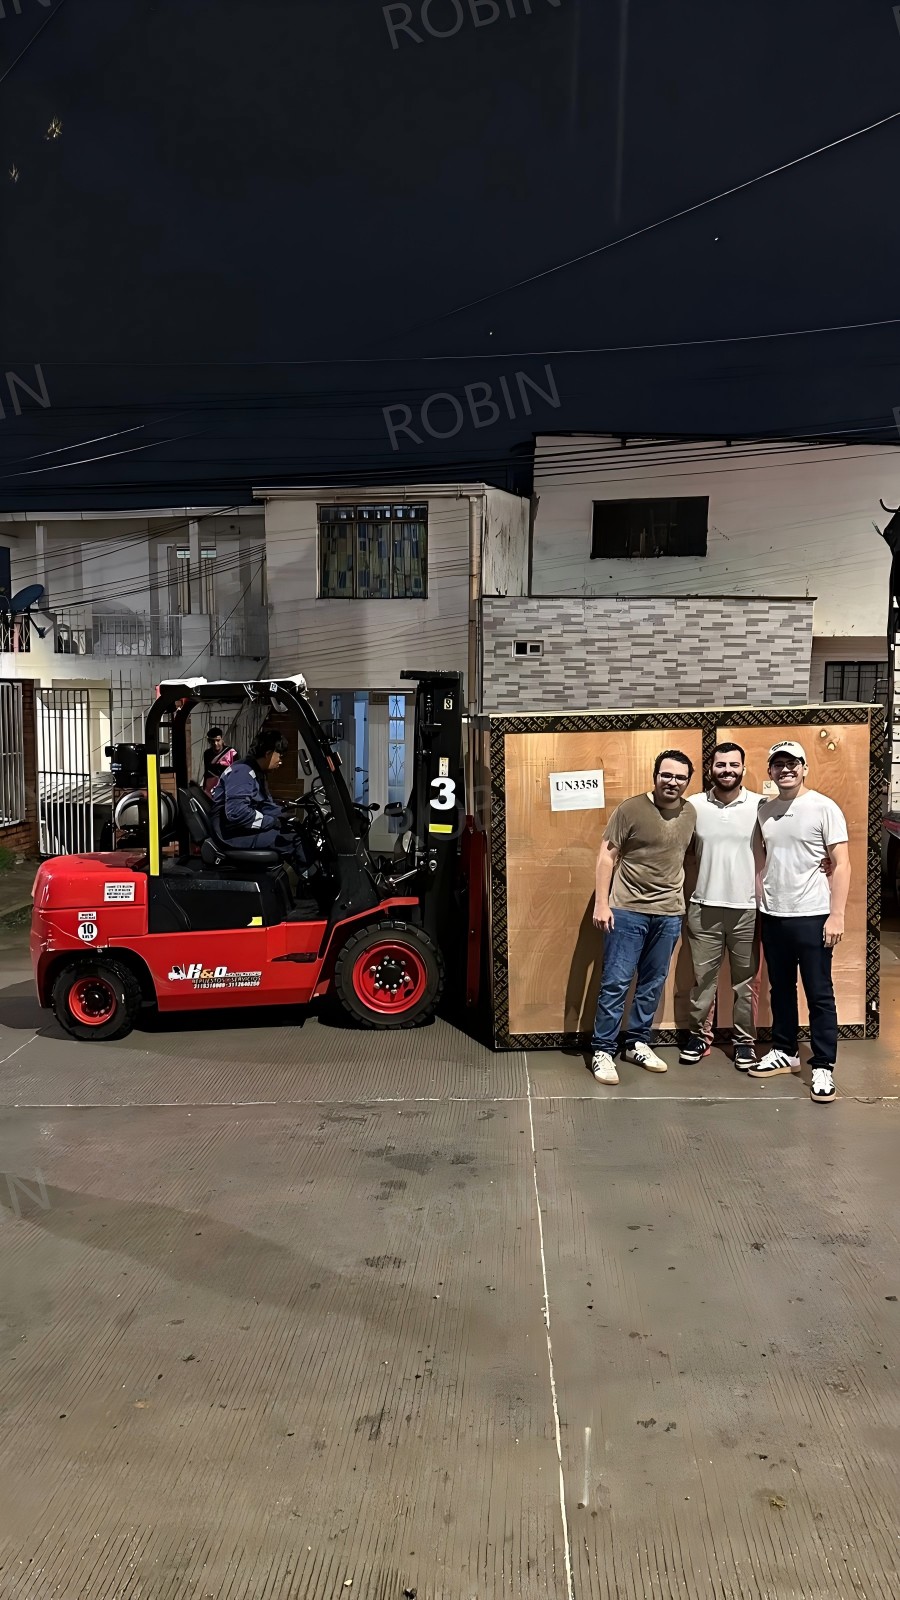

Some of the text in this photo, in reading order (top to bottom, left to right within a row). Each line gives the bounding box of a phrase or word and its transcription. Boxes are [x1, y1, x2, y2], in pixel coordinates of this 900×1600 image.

[556, 779, 599, 791] UN3358
[430, 777, 456, 810] 3
[81, 923, 94, 934] 10
